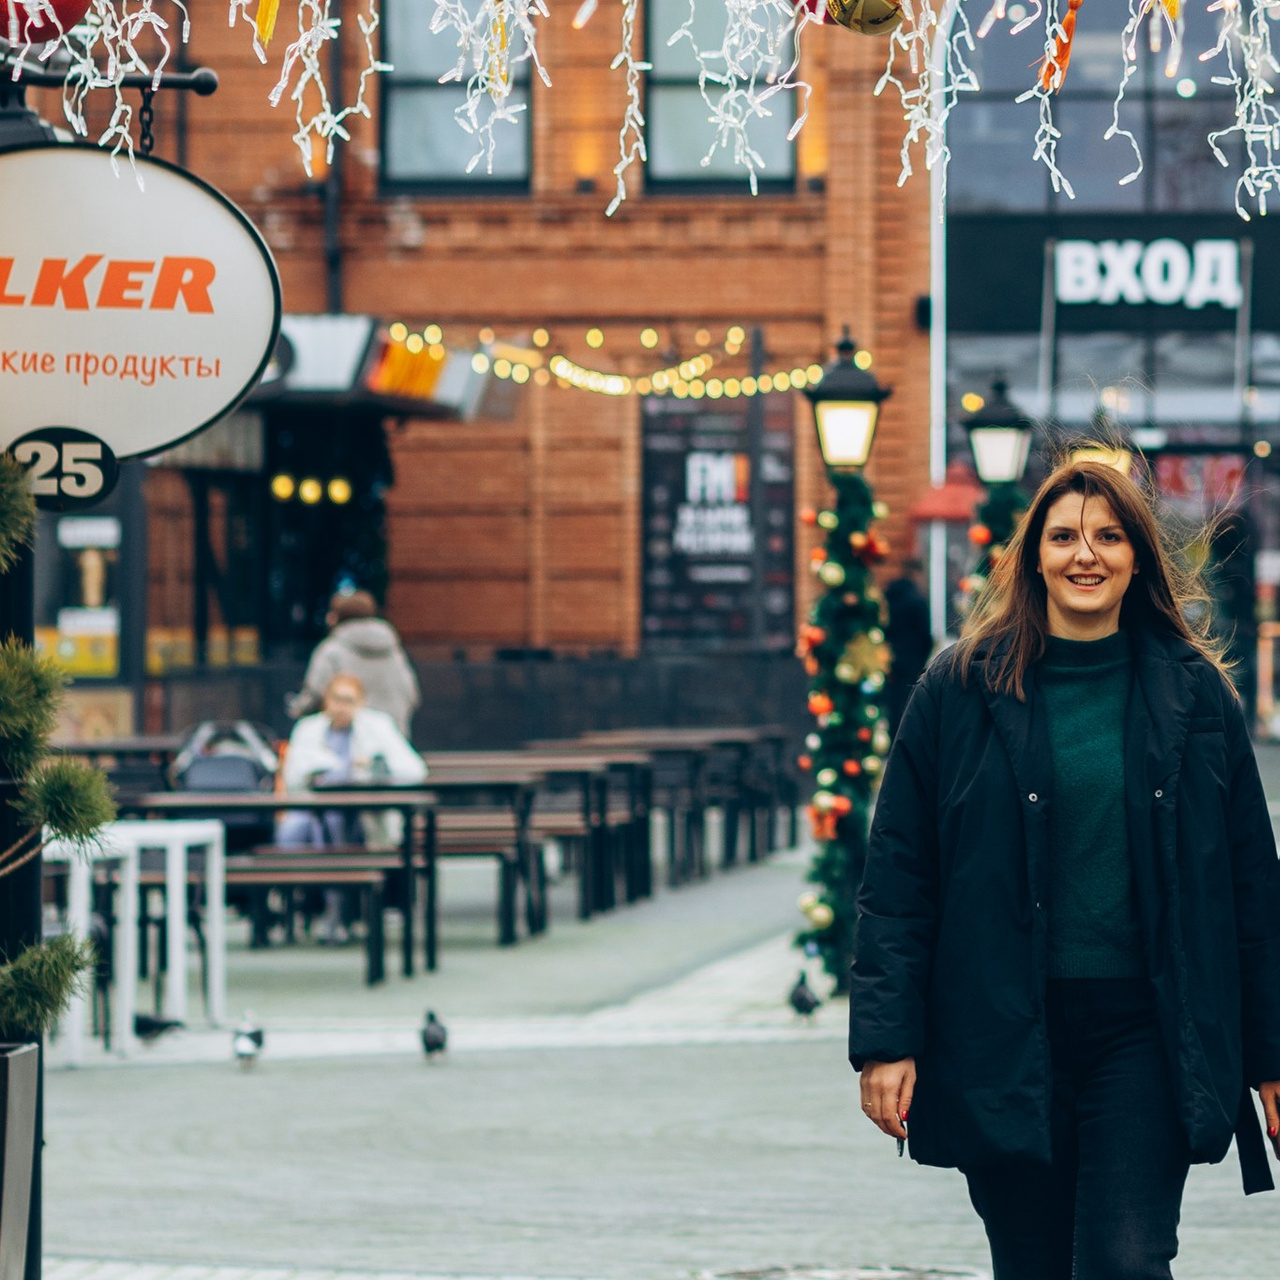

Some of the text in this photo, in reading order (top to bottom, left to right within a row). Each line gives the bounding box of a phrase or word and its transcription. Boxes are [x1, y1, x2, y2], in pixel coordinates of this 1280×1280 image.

[0, 254, 216, 315] LKER
[1055, 238, 1243, 309] ВХОД
[1, 351, 221, 387] кие продукты
[14, 440, 104, 498] 25
